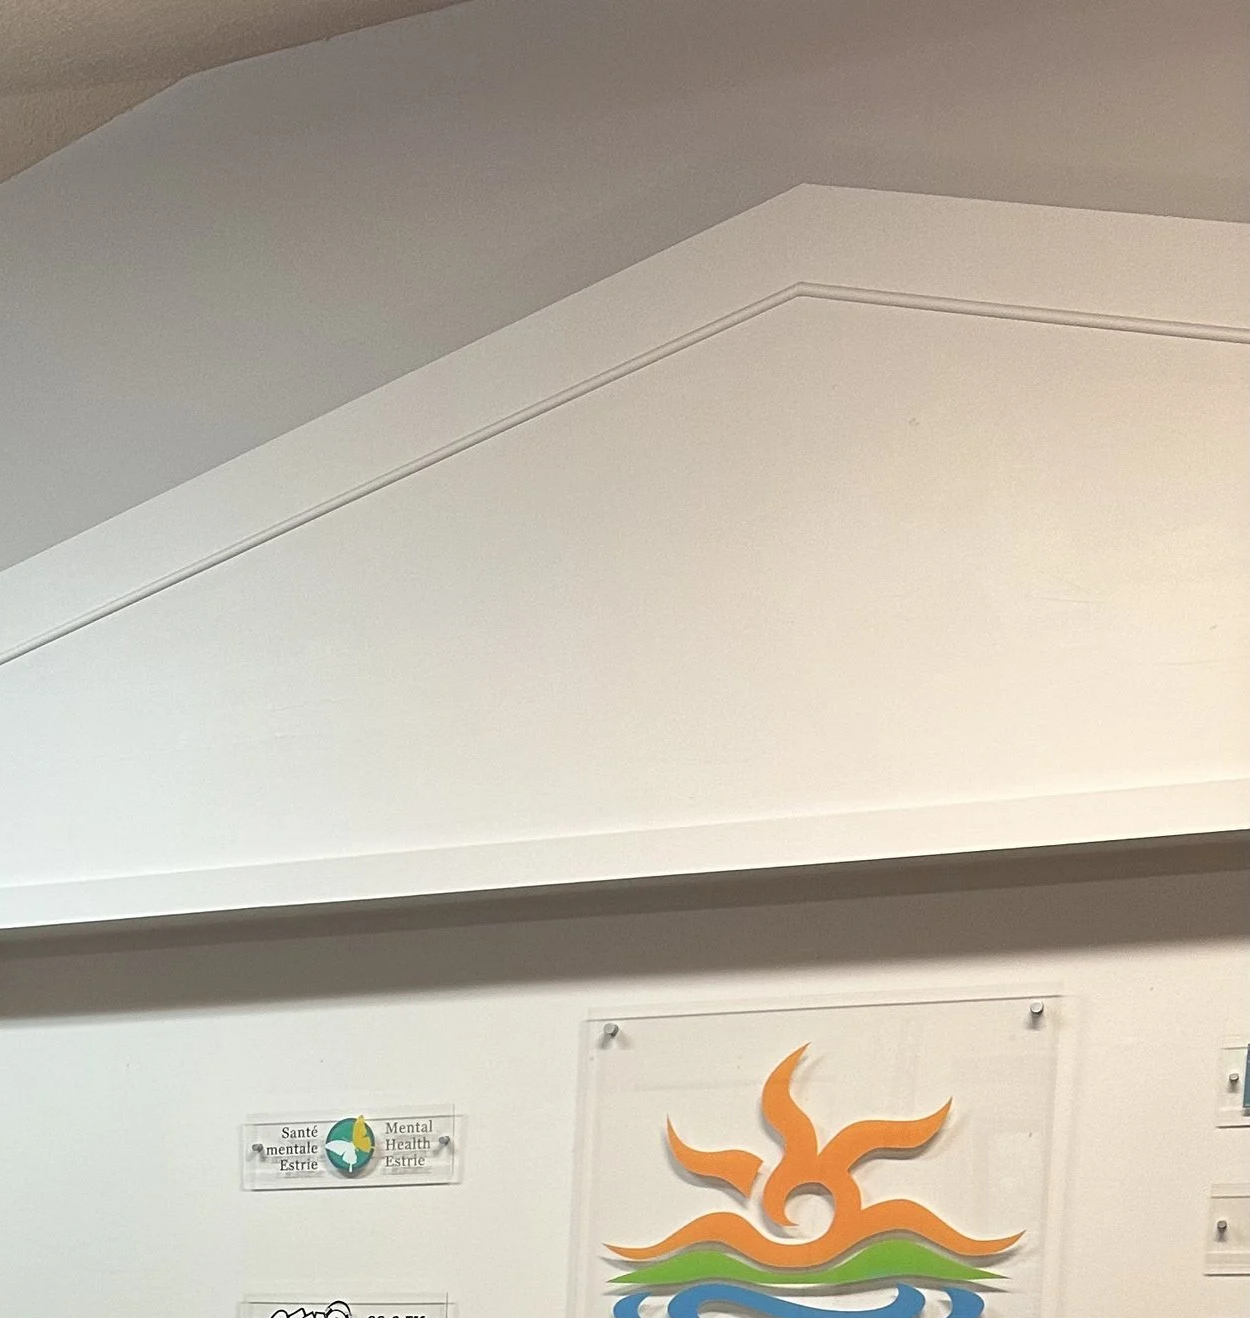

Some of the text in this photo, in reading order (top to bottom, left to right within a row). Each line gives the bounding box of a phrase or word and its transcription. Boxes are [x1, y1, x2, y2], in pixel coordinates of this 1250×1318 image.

[281, 1124, 318, 1139] Santé
[385, 1119, 433, 1134] Mental
[266, 1141, 318, 1155] mentale
[385, 1137, 431, 1150] Health
[280, 1159, 318, 1171] Estrie
[385, 1154, 426, 1167] Estrie
